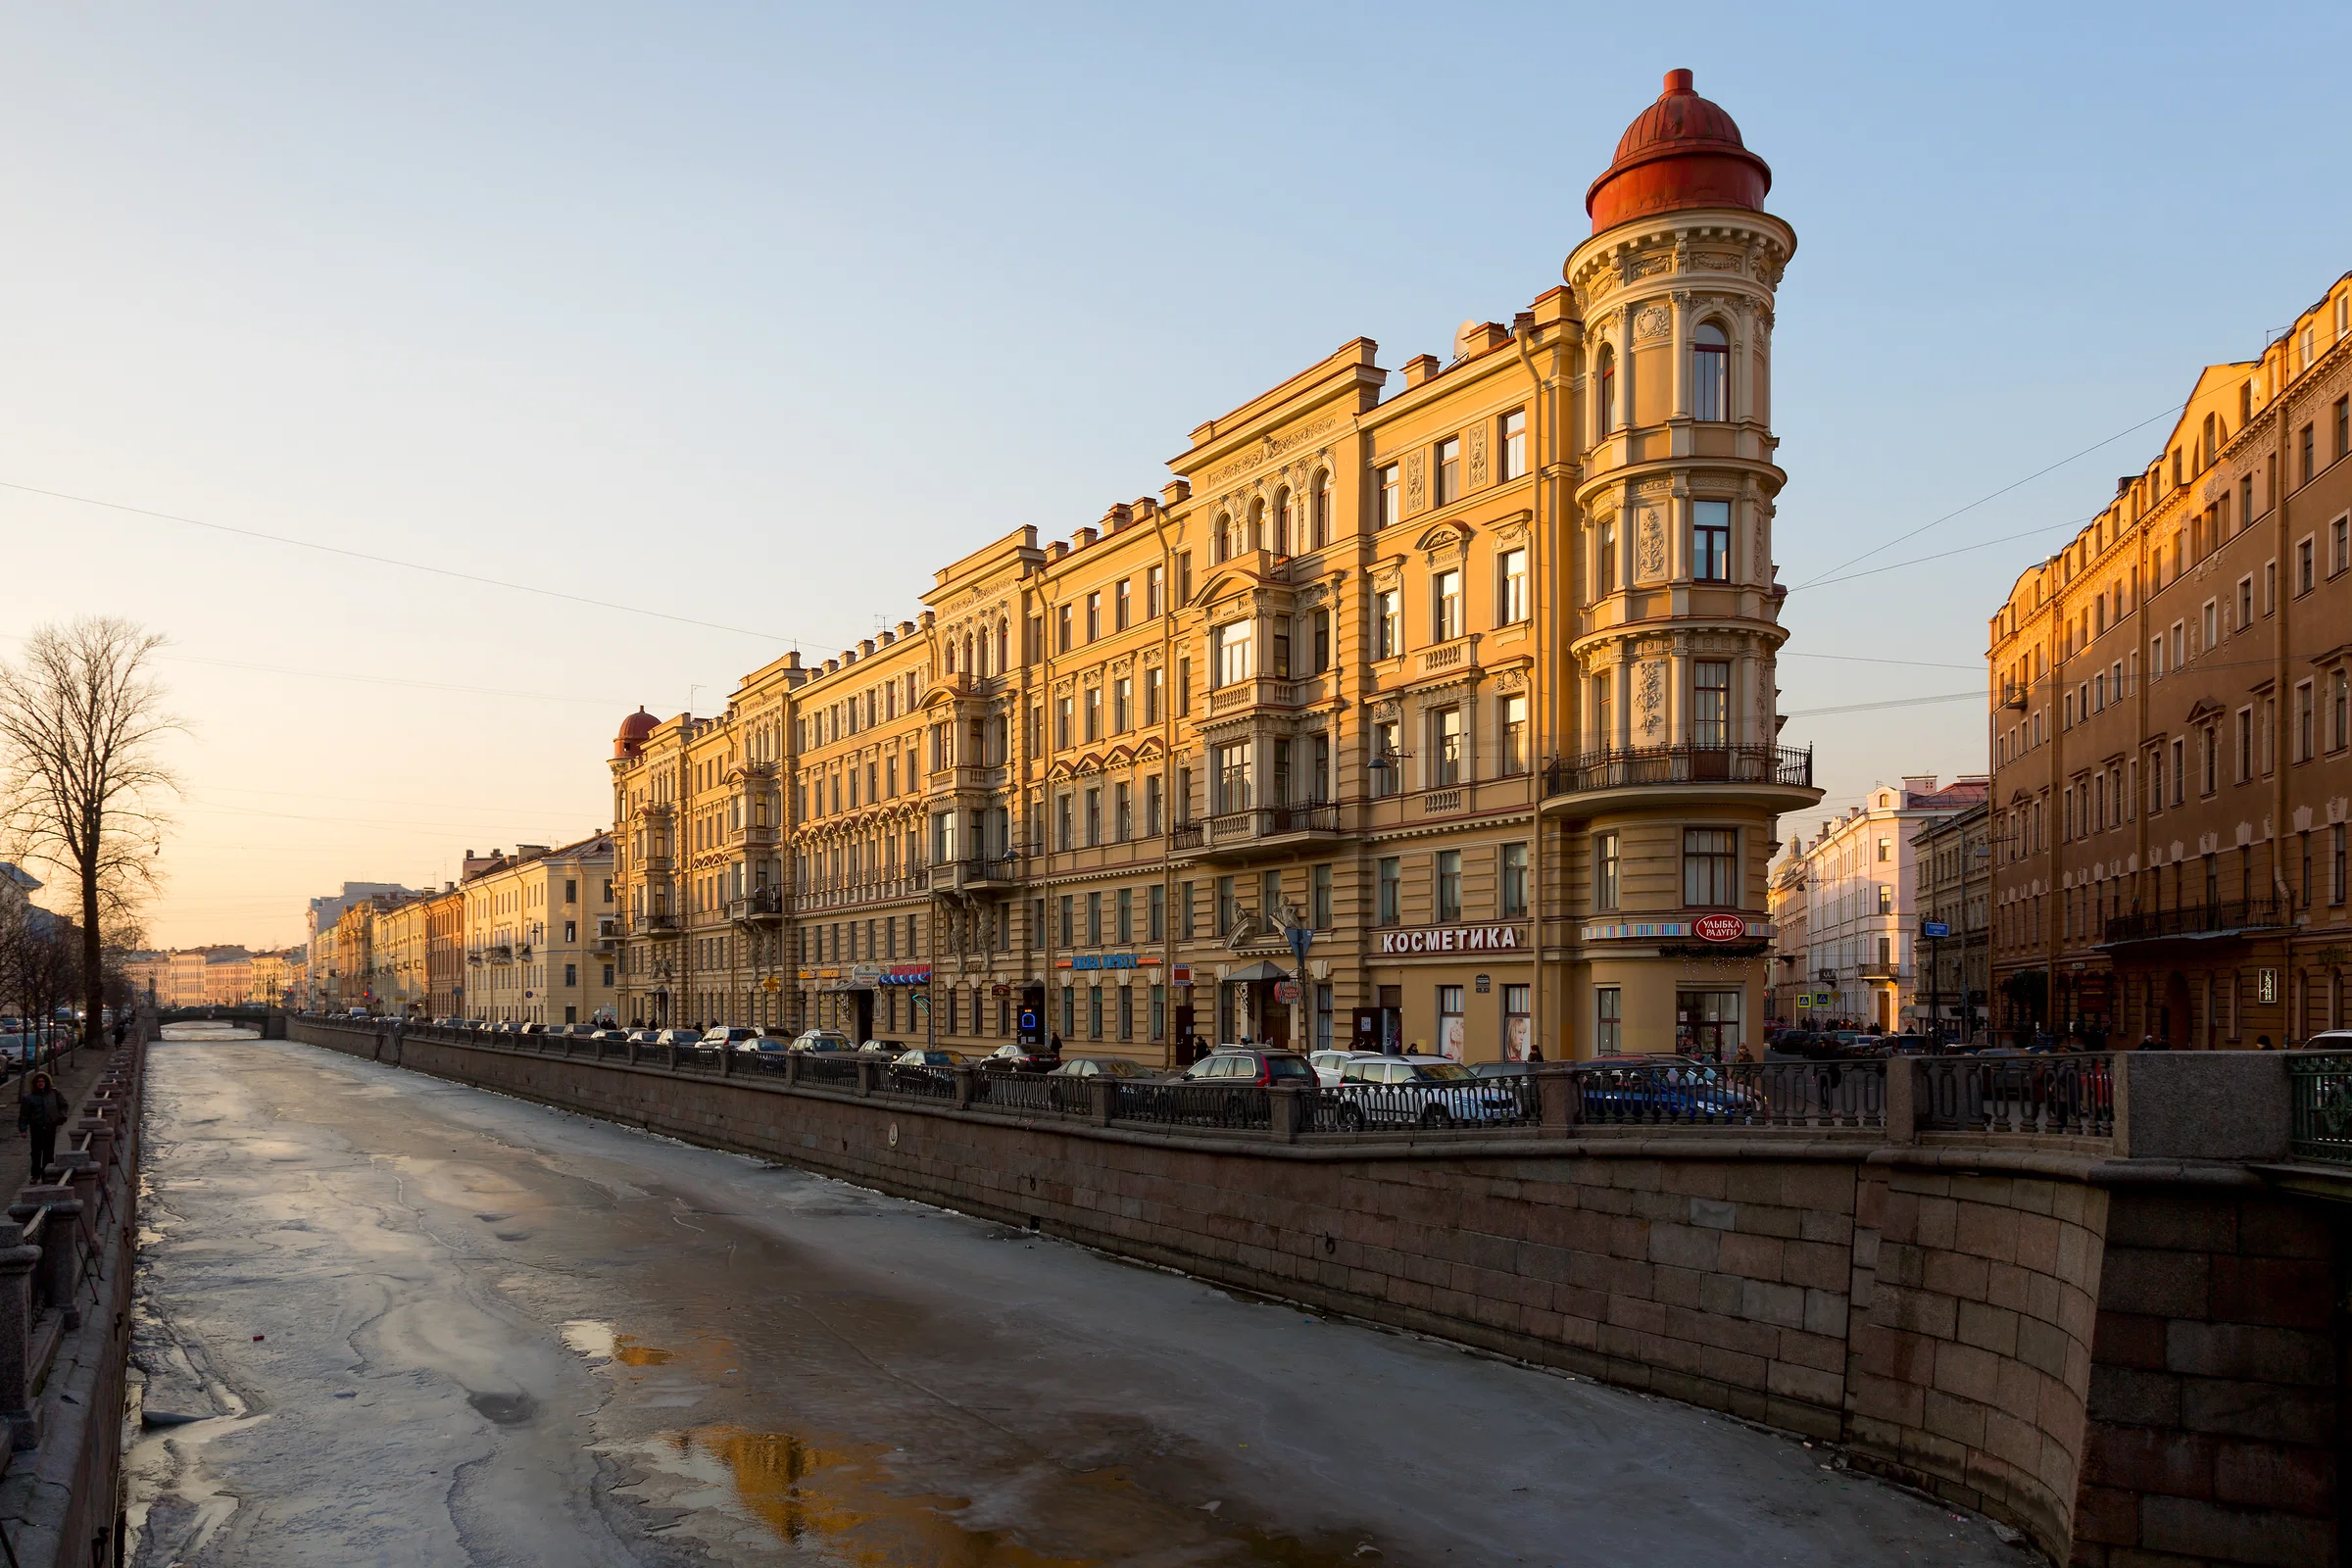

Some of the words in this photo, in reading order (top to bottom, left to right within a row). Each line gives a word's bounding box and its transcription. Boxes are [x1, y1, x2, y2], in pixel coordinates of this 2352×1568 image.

[1383, 926, 1516, 953] КОСМЕТИКА
[1072, 956, 1101, 970] НЕВА
[1102, 954, 1138, 969] ПРЕСС
[2260, 970, 2273, 1001] ТКАНИ
